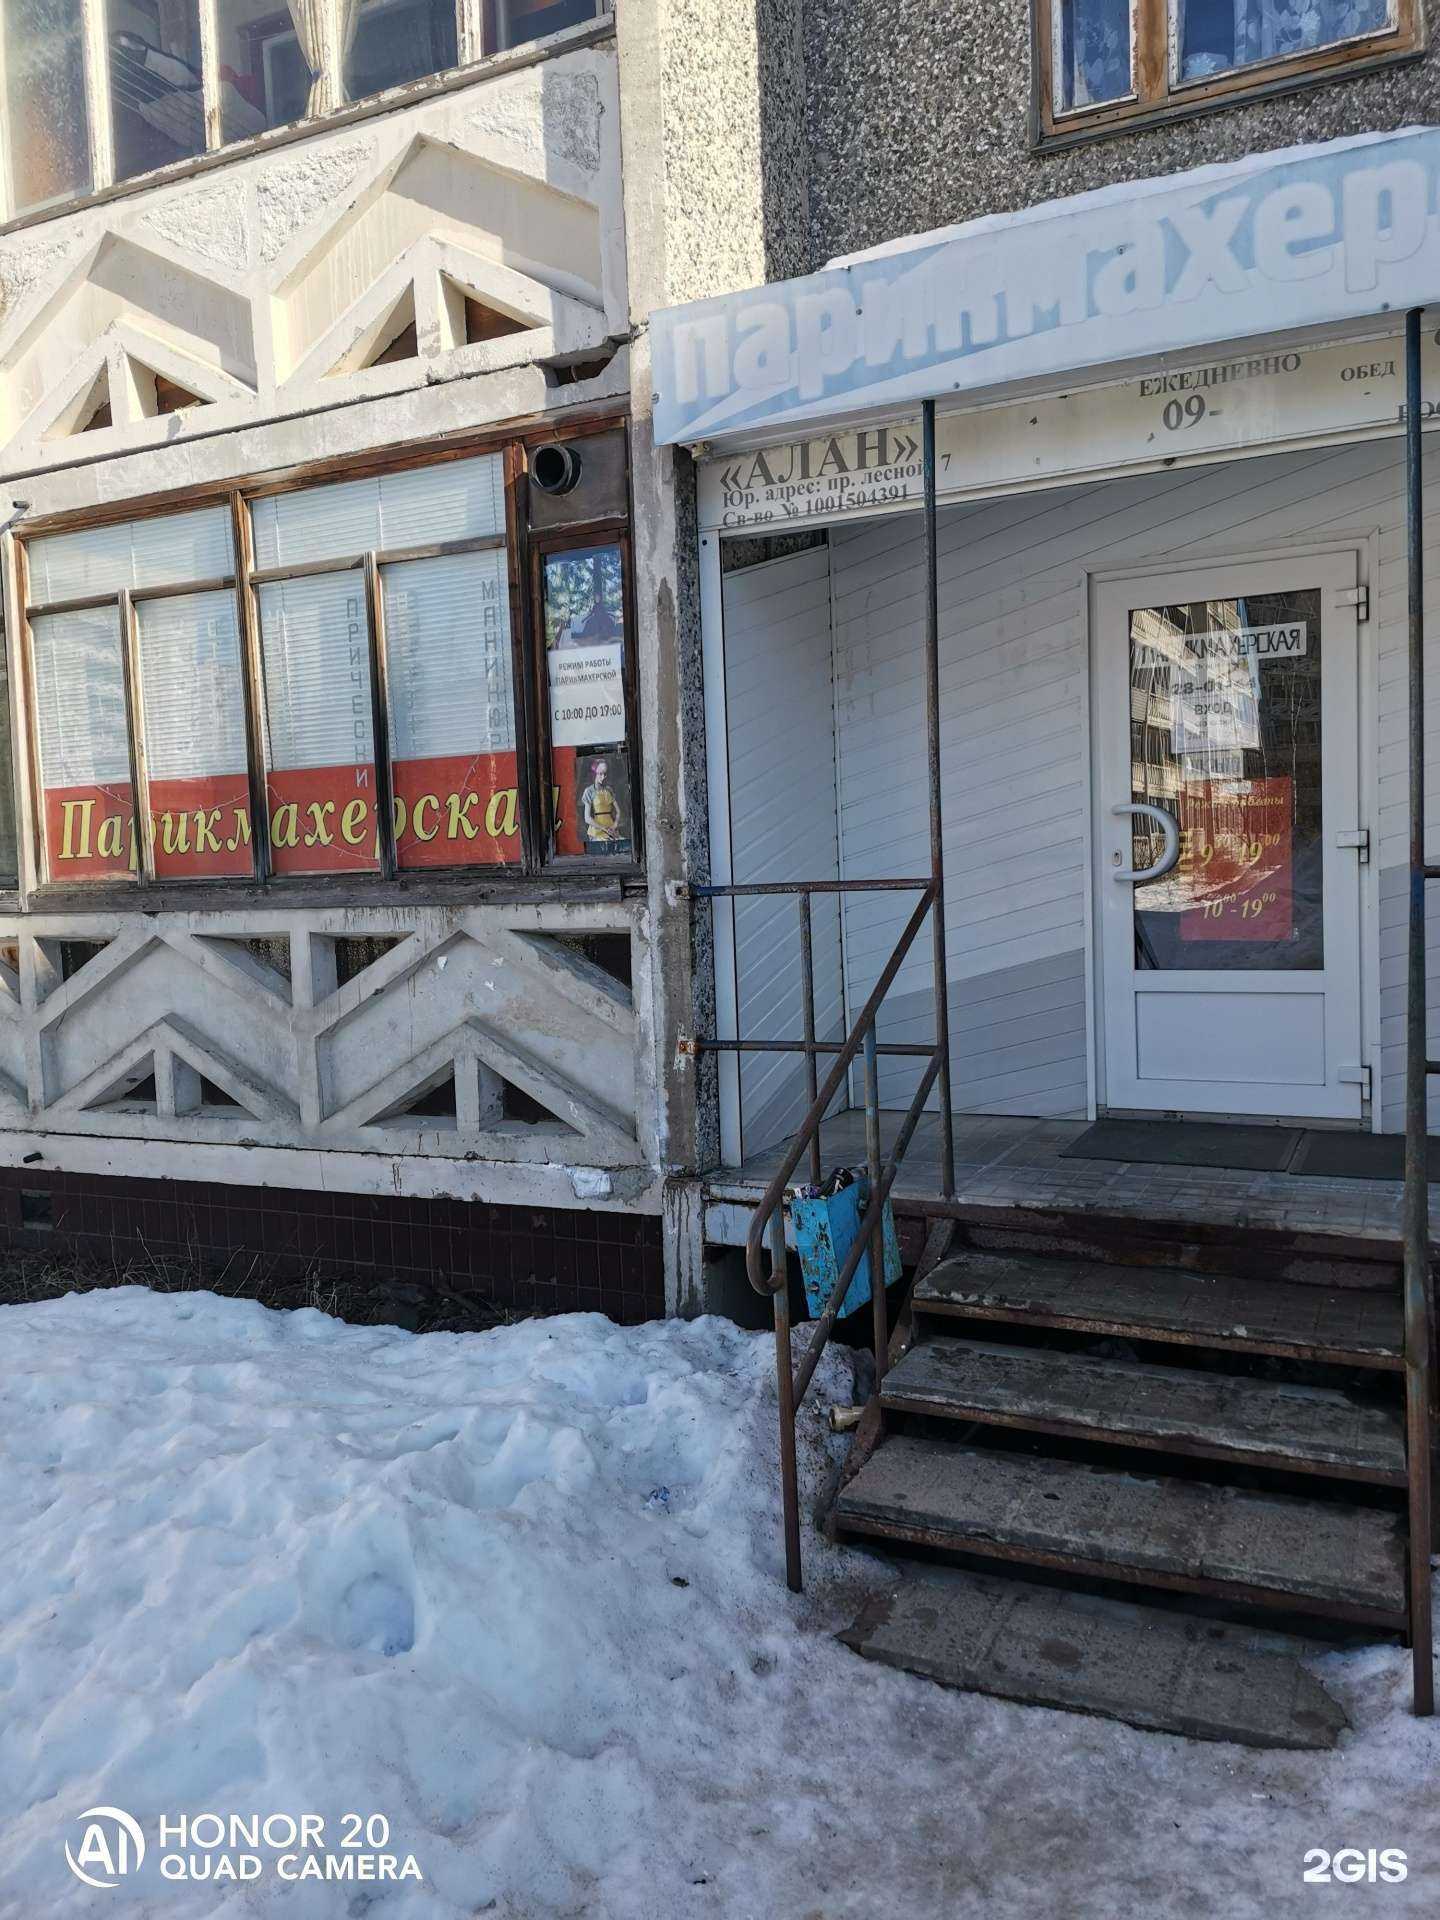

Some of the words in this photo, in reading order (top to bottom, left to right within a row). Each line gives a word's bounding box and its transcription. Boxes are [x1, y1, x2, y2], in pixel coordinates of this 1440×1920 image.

[673, 159, 1440, 403] парикмахер
[1139, 353, 1301, 397] ЕЖЕДНЕВНО
[1340, 360, 1396, 382] ОБЕД
[720, 428, 919, 492] «АЛАН»
[723, 489, 759, 509] Юр.
[765, 484, 820, 504] адрес:
[828, 476, 855, 491] пр.
[941, 453, 952, 473] 7
[723, 510, 773, 528] Св-во
[781, 502, 799, 519] №
[558, 662, 584, 671] РЕЖИМ
[585, 658, 611, 669] РАБОТЫ
[554, 710, 560, 721] С
[562, 707, 583, 720] 10:00
[585, 706, 598, 720] ДО
[600, 704, 622, 717] 19:00
